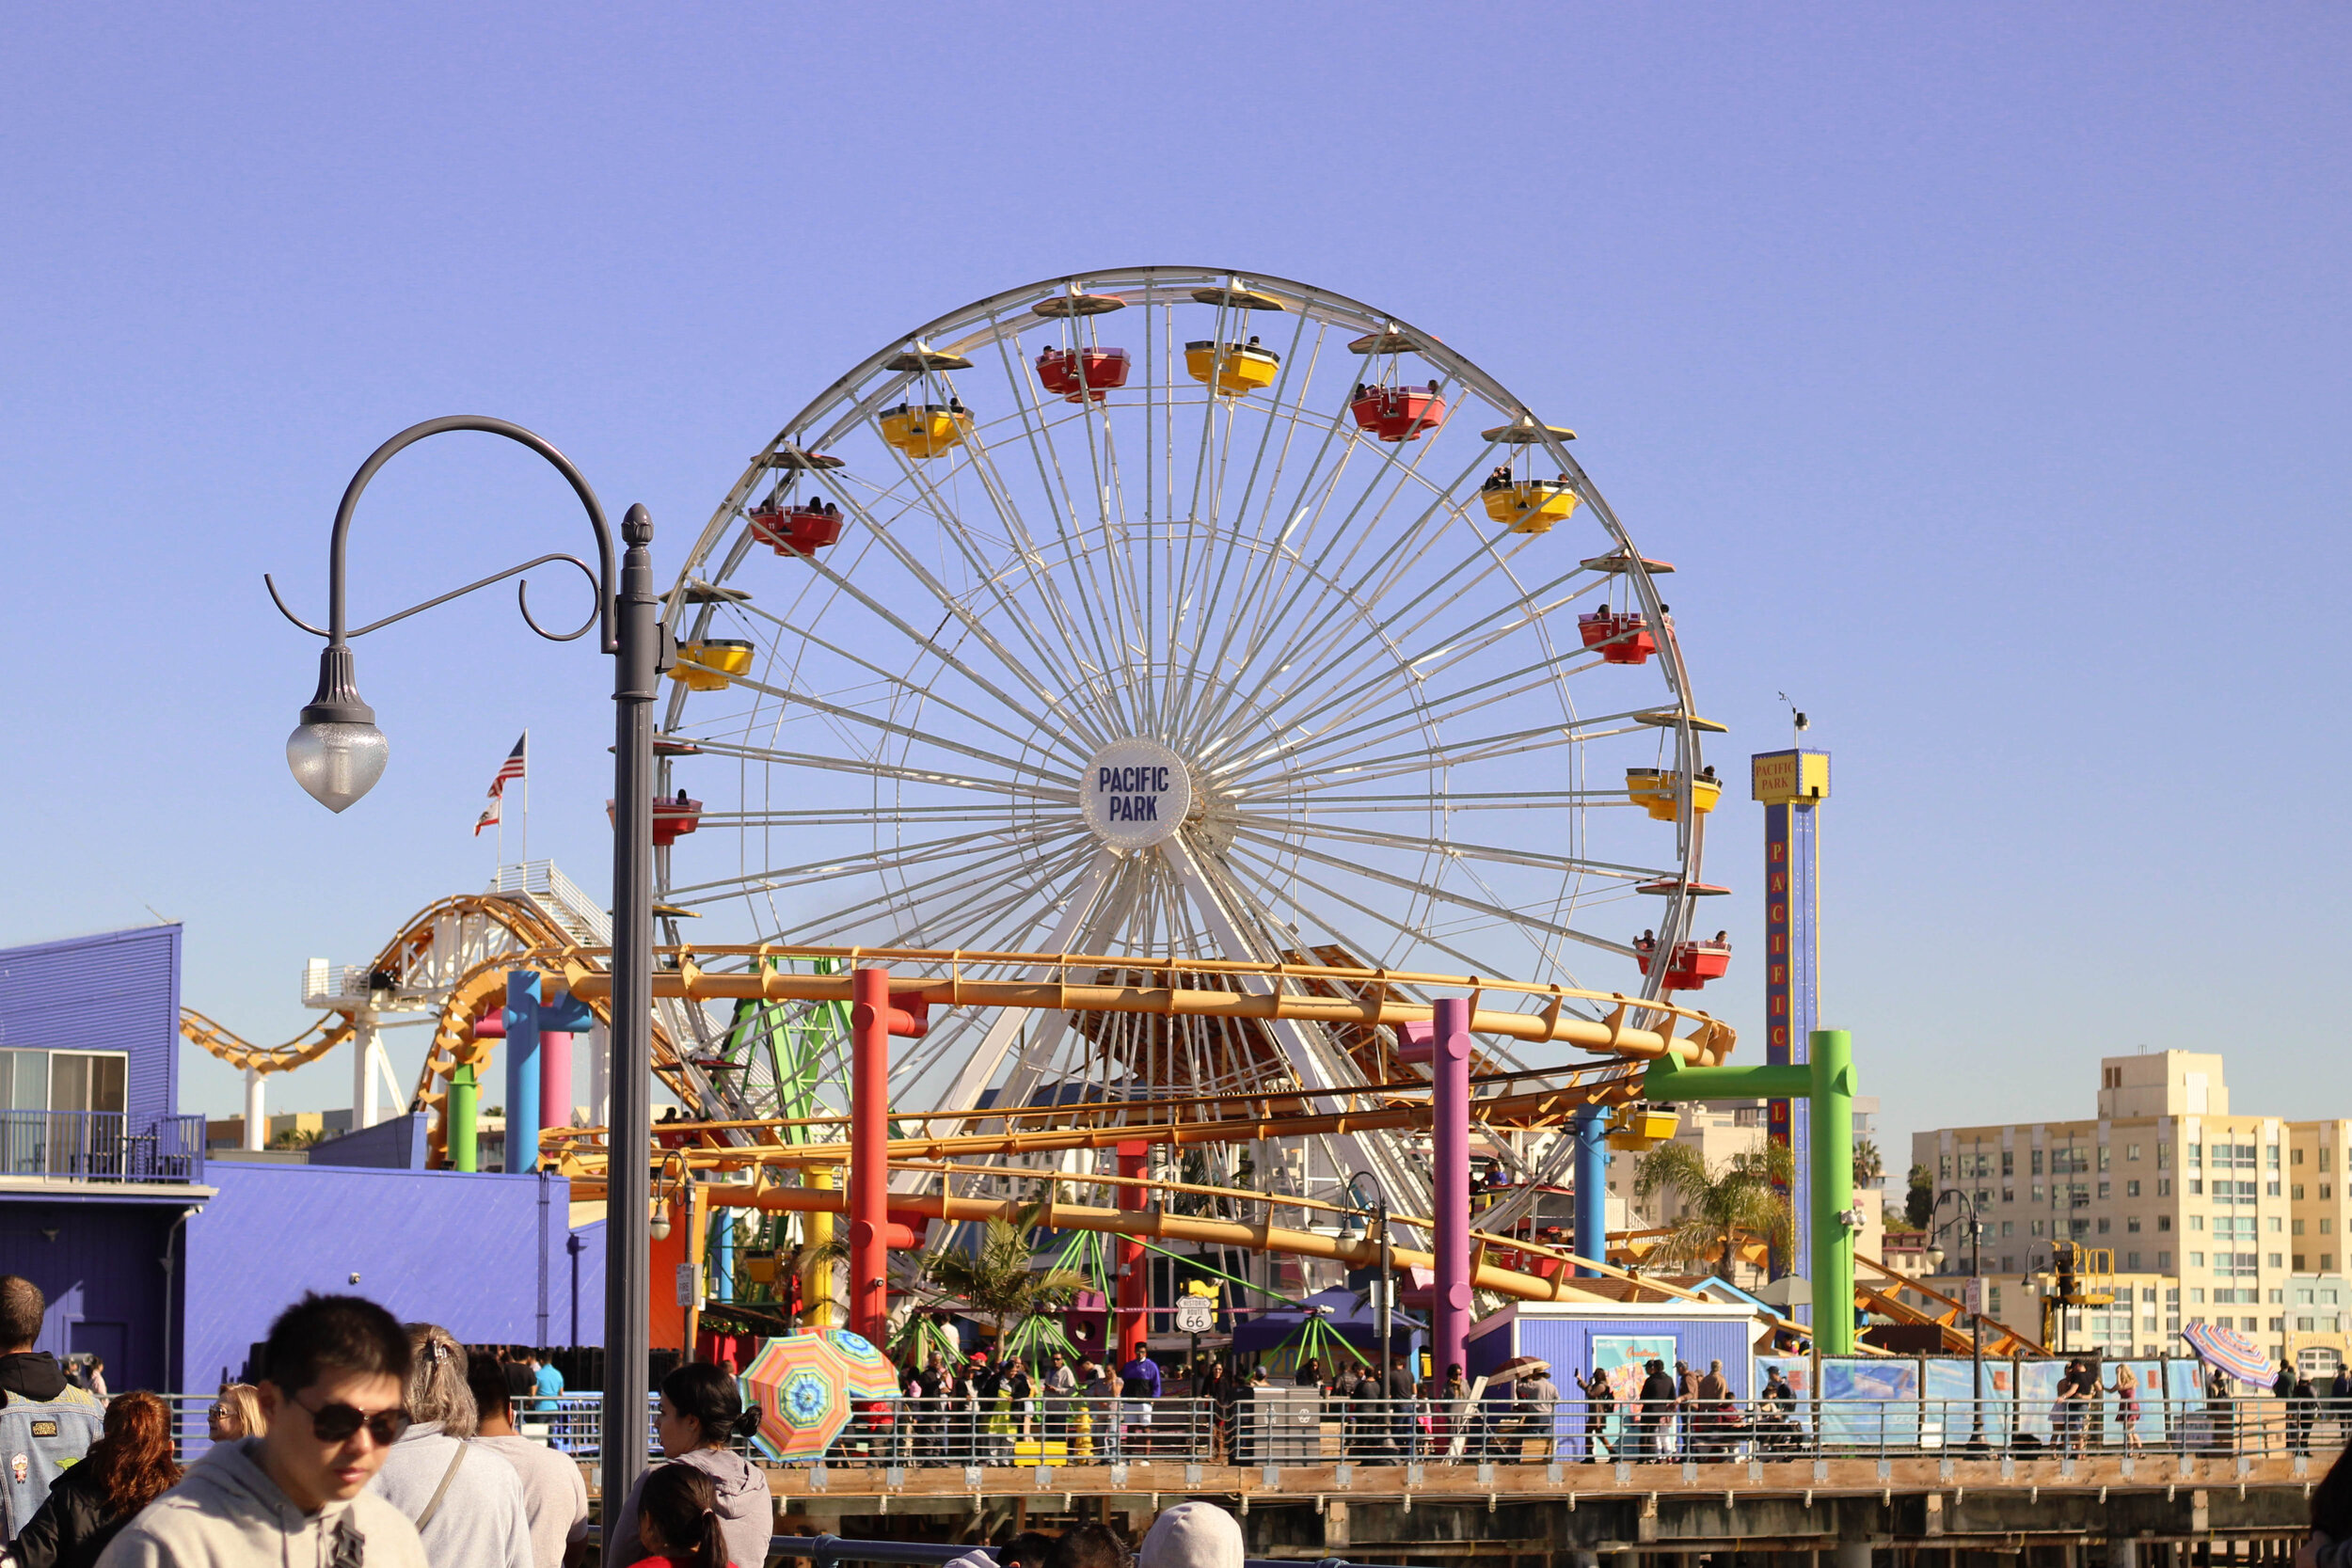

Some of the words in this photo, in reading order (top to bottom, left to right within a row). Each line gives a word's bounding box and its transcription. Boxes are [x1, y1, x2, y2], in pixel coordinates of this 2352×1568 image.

[1756, 761, 1795, 777] PACIFIC
[1099, 767, 1169, 792] PACIFIC
[1762, 777, 1788, 791] PARK
[1109, 796, 1158, 821] PARK
[1771, 843, 1785, 1046] PACIFIC
[1186, 1316, 1204, 1327] 66
